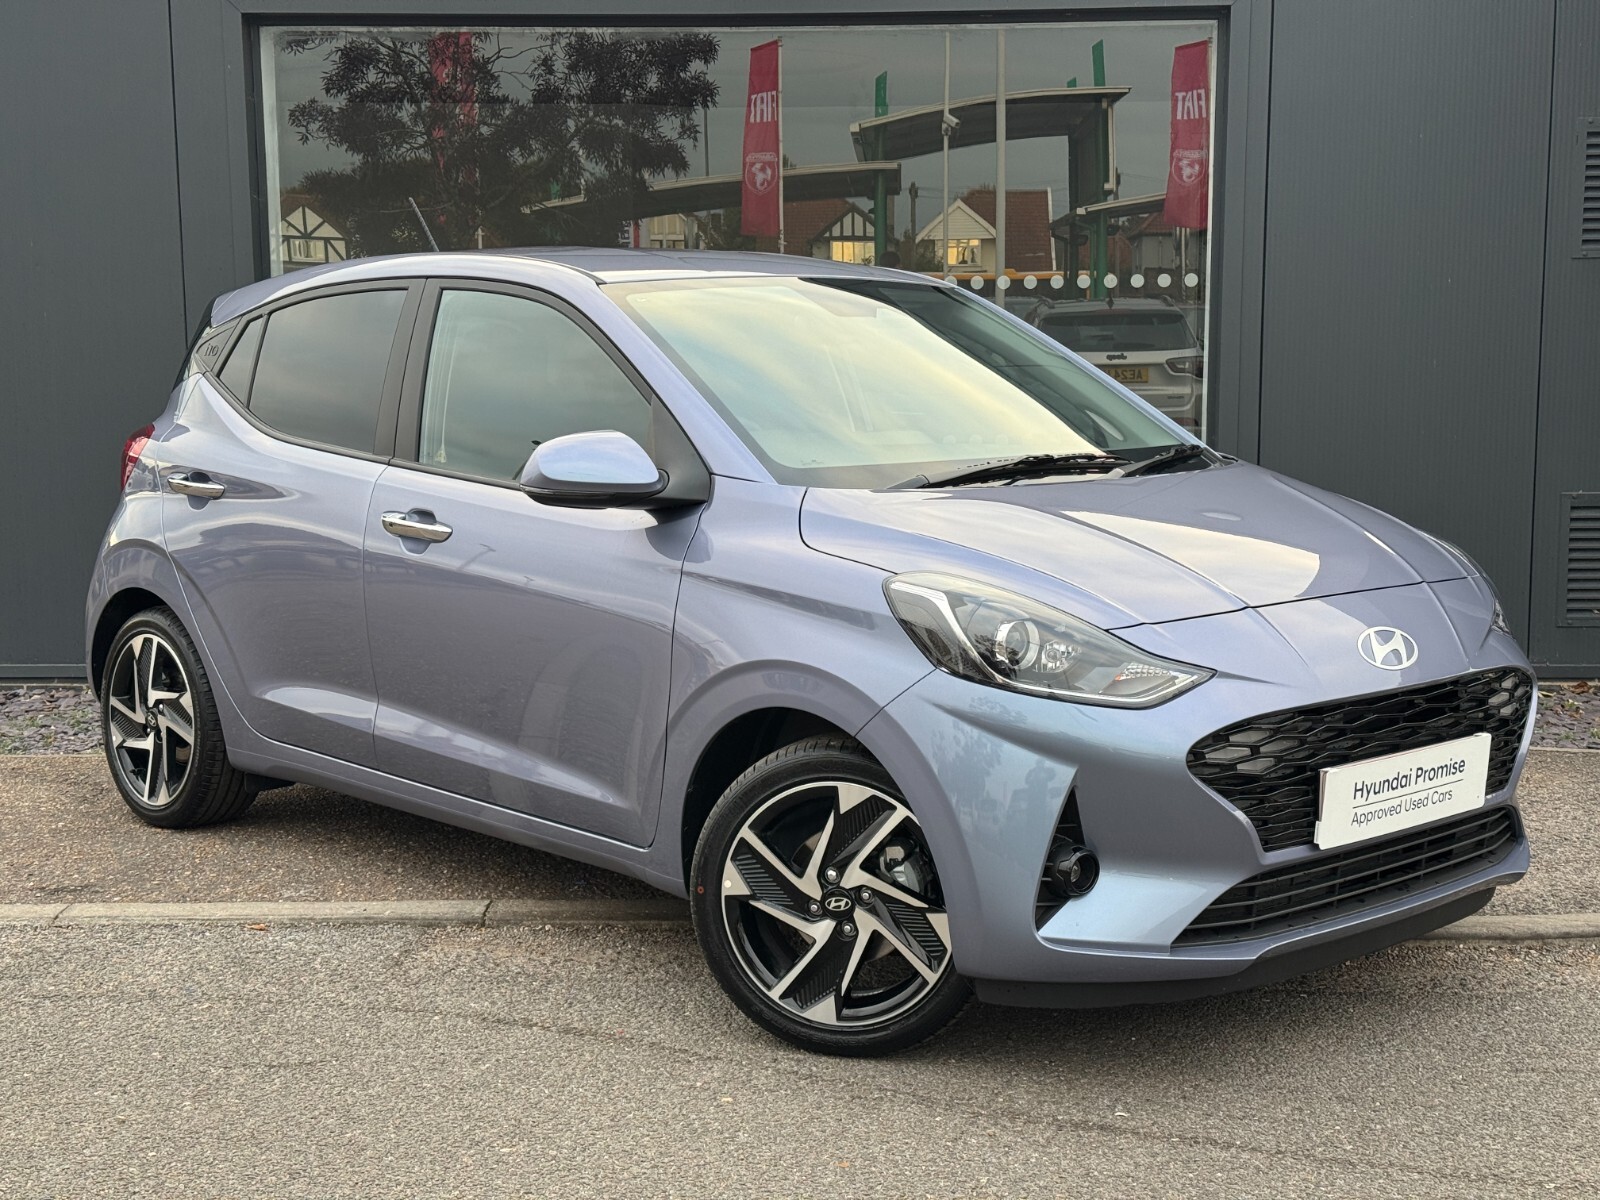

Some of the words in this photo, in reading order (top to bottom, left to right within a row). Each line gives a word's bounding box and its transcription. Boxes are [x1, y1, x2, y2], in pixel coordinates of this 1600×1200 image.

[1353, 768, 1413, 802] Hyundai
[1414, 758, 1466, 786] Promise
[1350, 799, 1403, 828] Approved
[1404, 793, 1429, 812] Used
[1431, 788, 1453, 805] Cars
